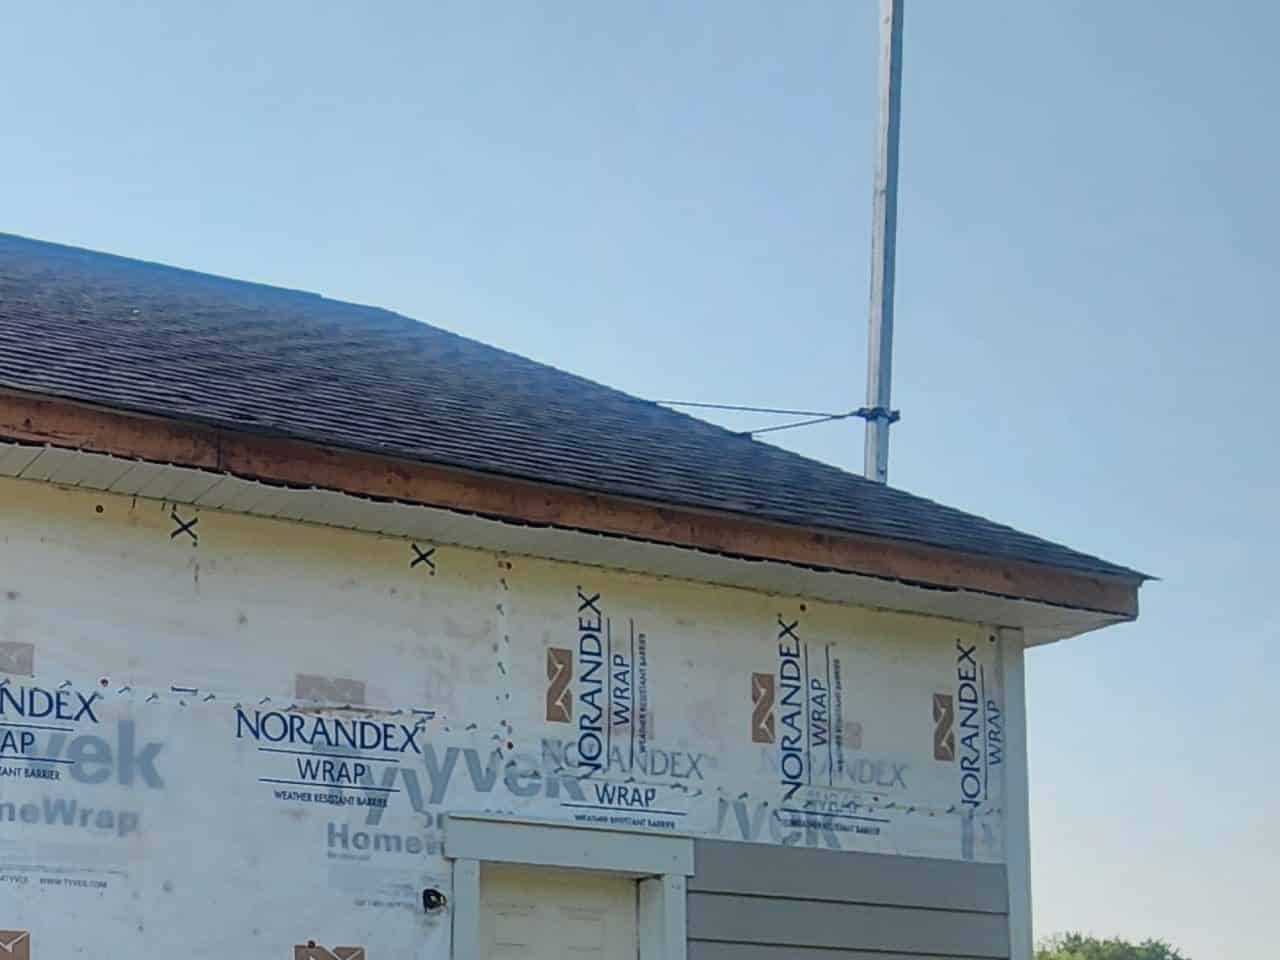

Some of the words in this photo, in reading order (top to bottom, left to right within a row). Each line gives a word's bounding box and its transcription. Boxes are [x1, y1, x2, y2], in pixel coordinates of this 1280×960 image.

[577, 590, 603, 781] NORANDEX
[612, 654, 631, 726] WRAP
[777, 617, 804, 801] NORANDEX
[811, 678, 828, 748] WRAP
[235, 709, 422, 754] NORANDEX
[956, 643, 982, 809] ORANDEX
[987, 700, 1004, 766] WRAP
[24, 768, 61, 780] BARRIER
[273, 789, 313, 802] WEATHER
[296, 758, 366, 785] WRAP
[594, 782, 657, 808] WRAP
